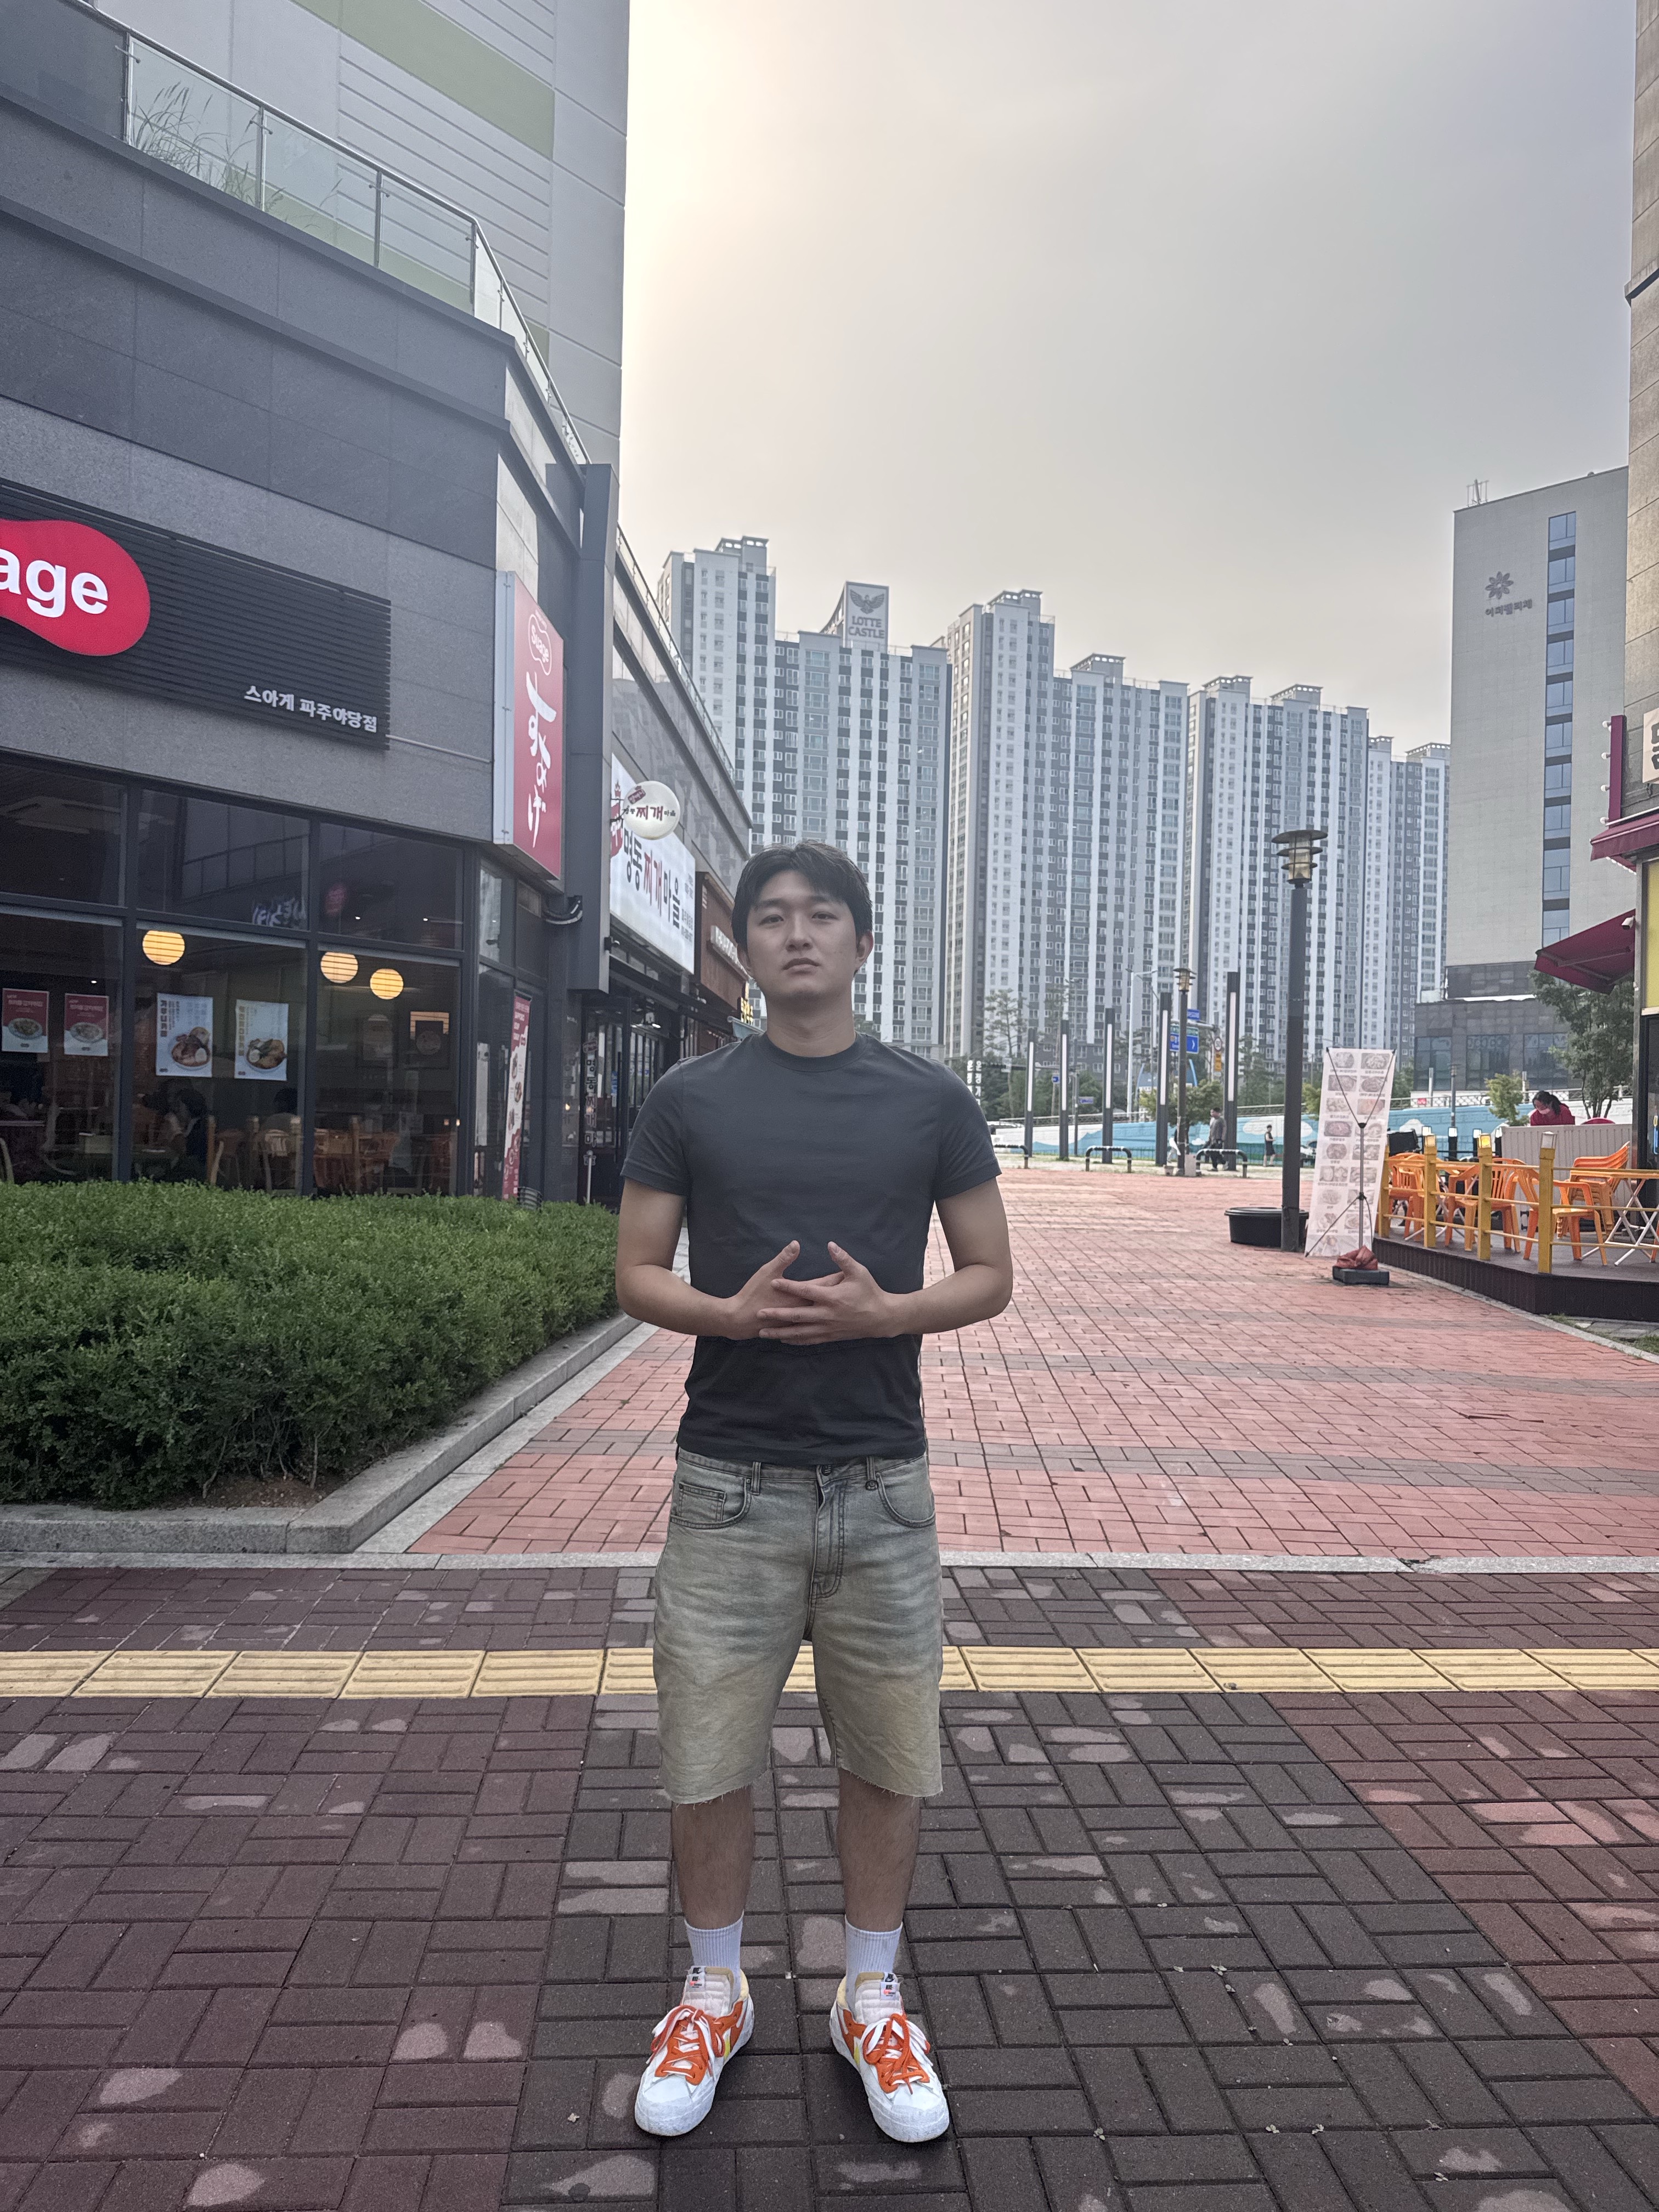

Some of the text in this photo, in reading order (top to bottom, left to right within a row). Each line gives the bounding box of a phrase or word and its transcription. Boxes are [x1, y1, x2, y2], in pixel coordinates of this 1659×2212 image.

[848, 626, 885, 639] CASTLE
[851, 615, 882, 628] LOTTE
[244, 685, 378, 733] 스아게 파주야당점
[623, 828, 680, 930] 명동찌개마을
